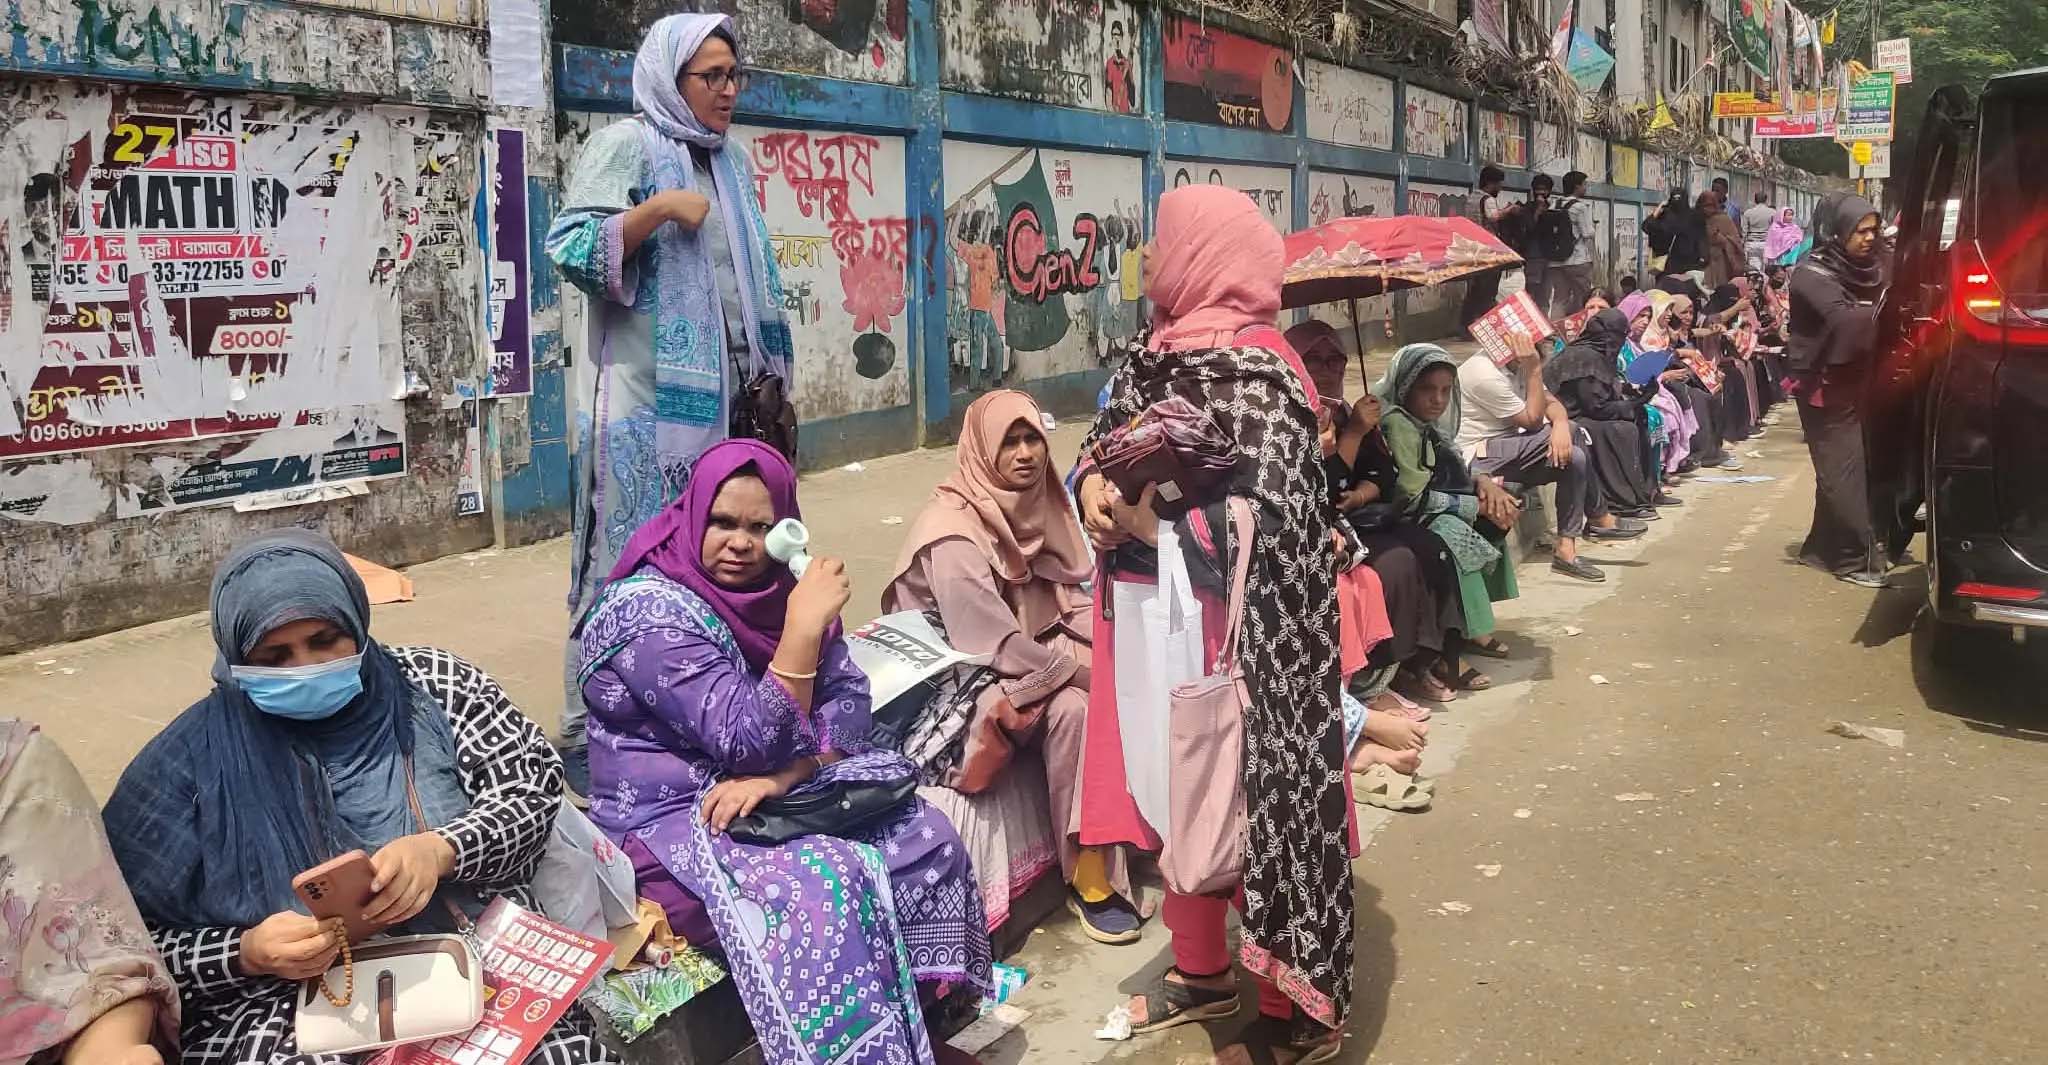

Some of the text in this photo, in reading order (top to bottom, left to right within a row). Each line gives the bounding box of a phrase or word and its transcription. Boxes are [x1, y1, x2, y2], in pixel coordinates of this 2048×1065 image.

[113, 124, 176, 163] 27
[176, 141, 230, 167] HSC
[101, 175, 237, 229] MATH
[274, 300, 289, 320] ১
[460, 495, 476, 511] 28
